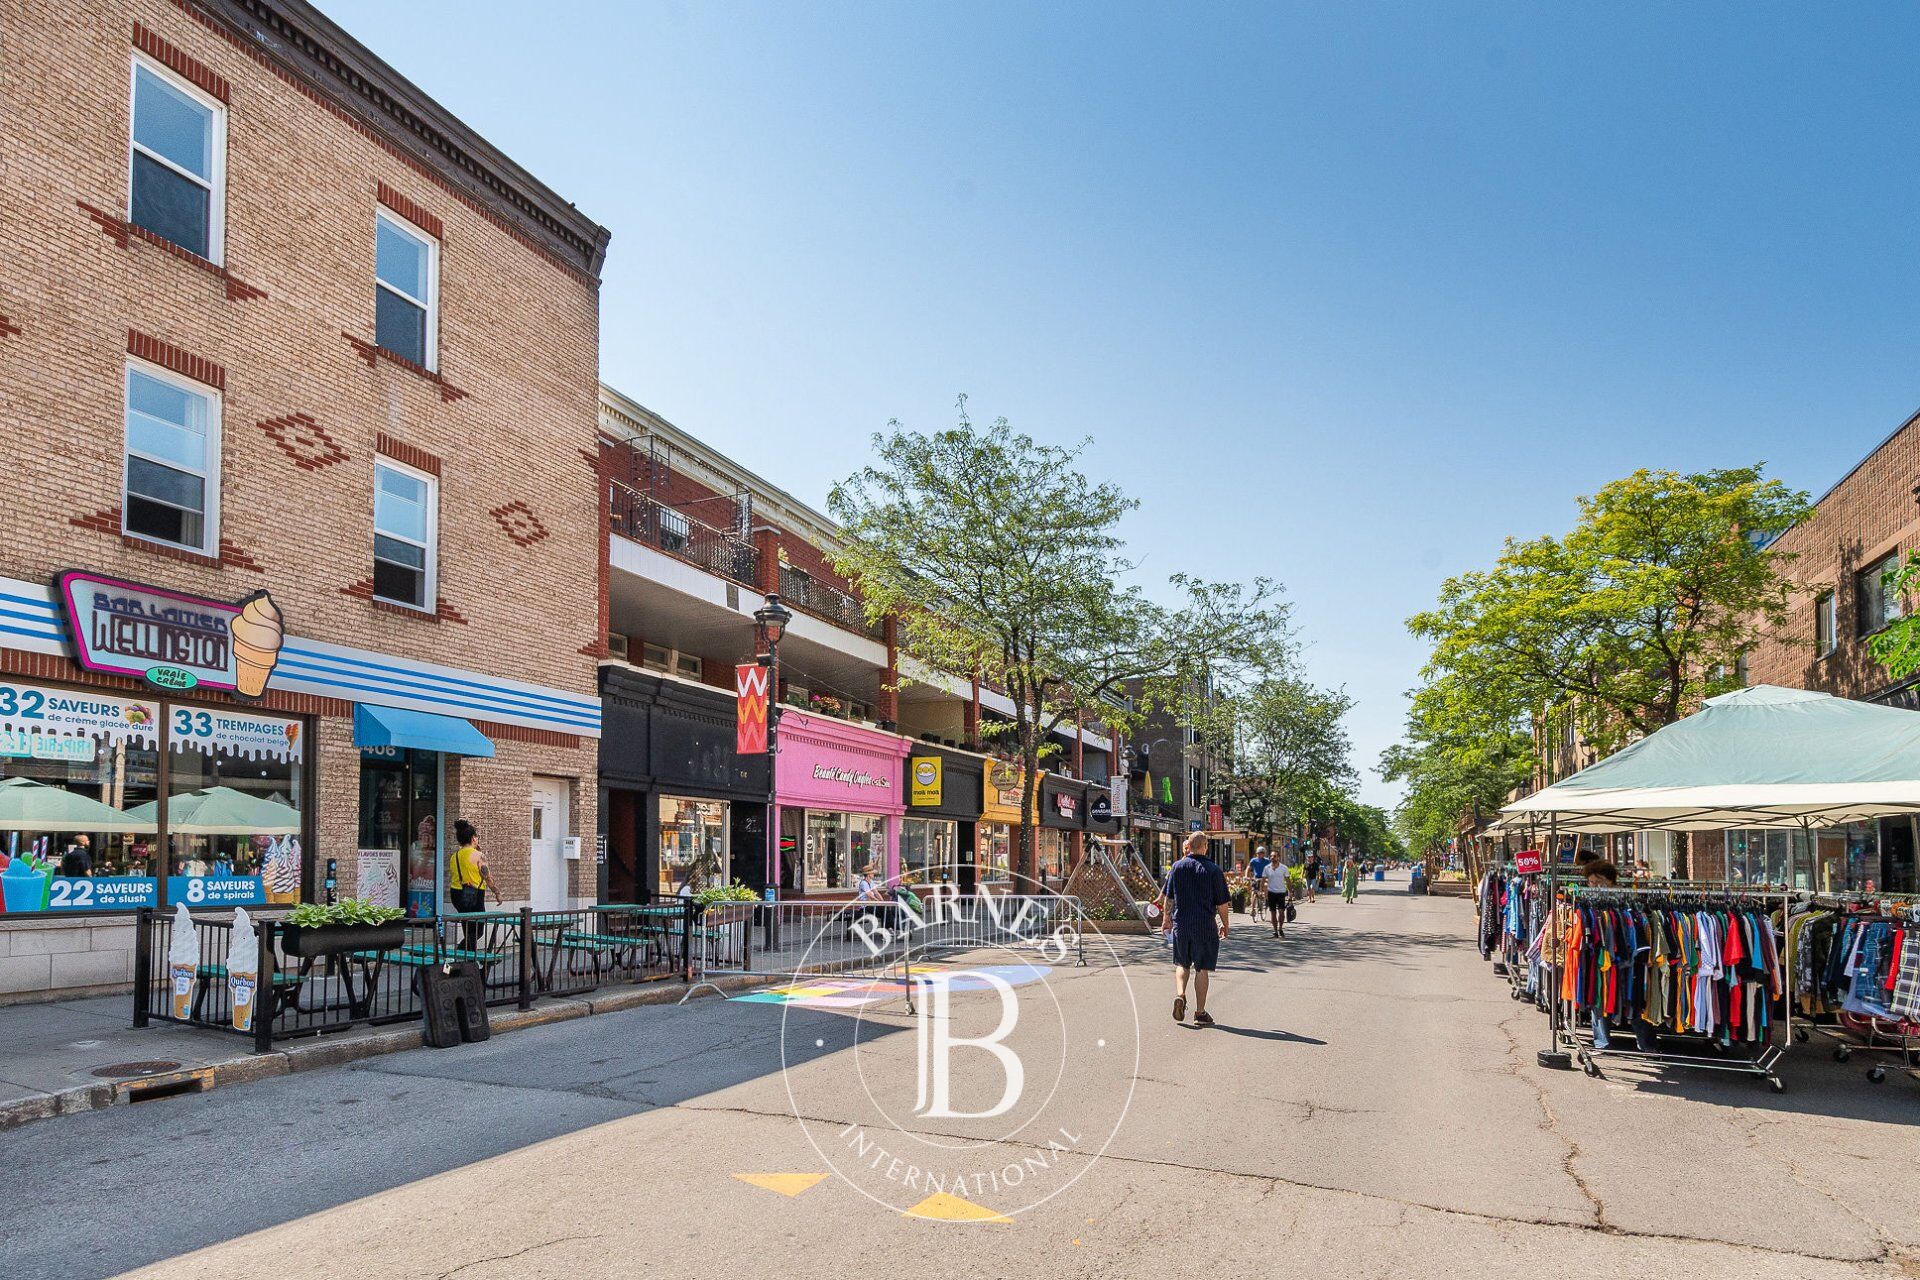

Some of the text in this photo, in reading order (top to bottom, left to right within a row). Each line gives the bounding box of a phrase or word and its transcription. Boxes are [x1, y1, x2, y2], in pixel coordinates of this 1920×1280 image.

[93, 592, 228, 633] BAR LAITIER
[92, 610, 229, 672] WELLINGTON
[0, 686, 45, 720] 32
[48, 697, 121, 718] SAVEURS
[48, 713, 154, 732] de crème glacée dure
[174, 709, 213, 738] 33
[216, 718, 284, 736] TREMPAGES
[230, 733, 265, 743] chocolat
[267, 737, 289, 747] belge
[1518, 856, 1538, 866] 50%
[50, 880, 94, 907] 22
[96, 882, 153, 895] SAVEURS
[186, 879, 205, 903] 8
[207, 880, 255, 891] SAVEURS
[100, 893, 147, 904] de slush
[208, 890, 255, 901] de spirals
